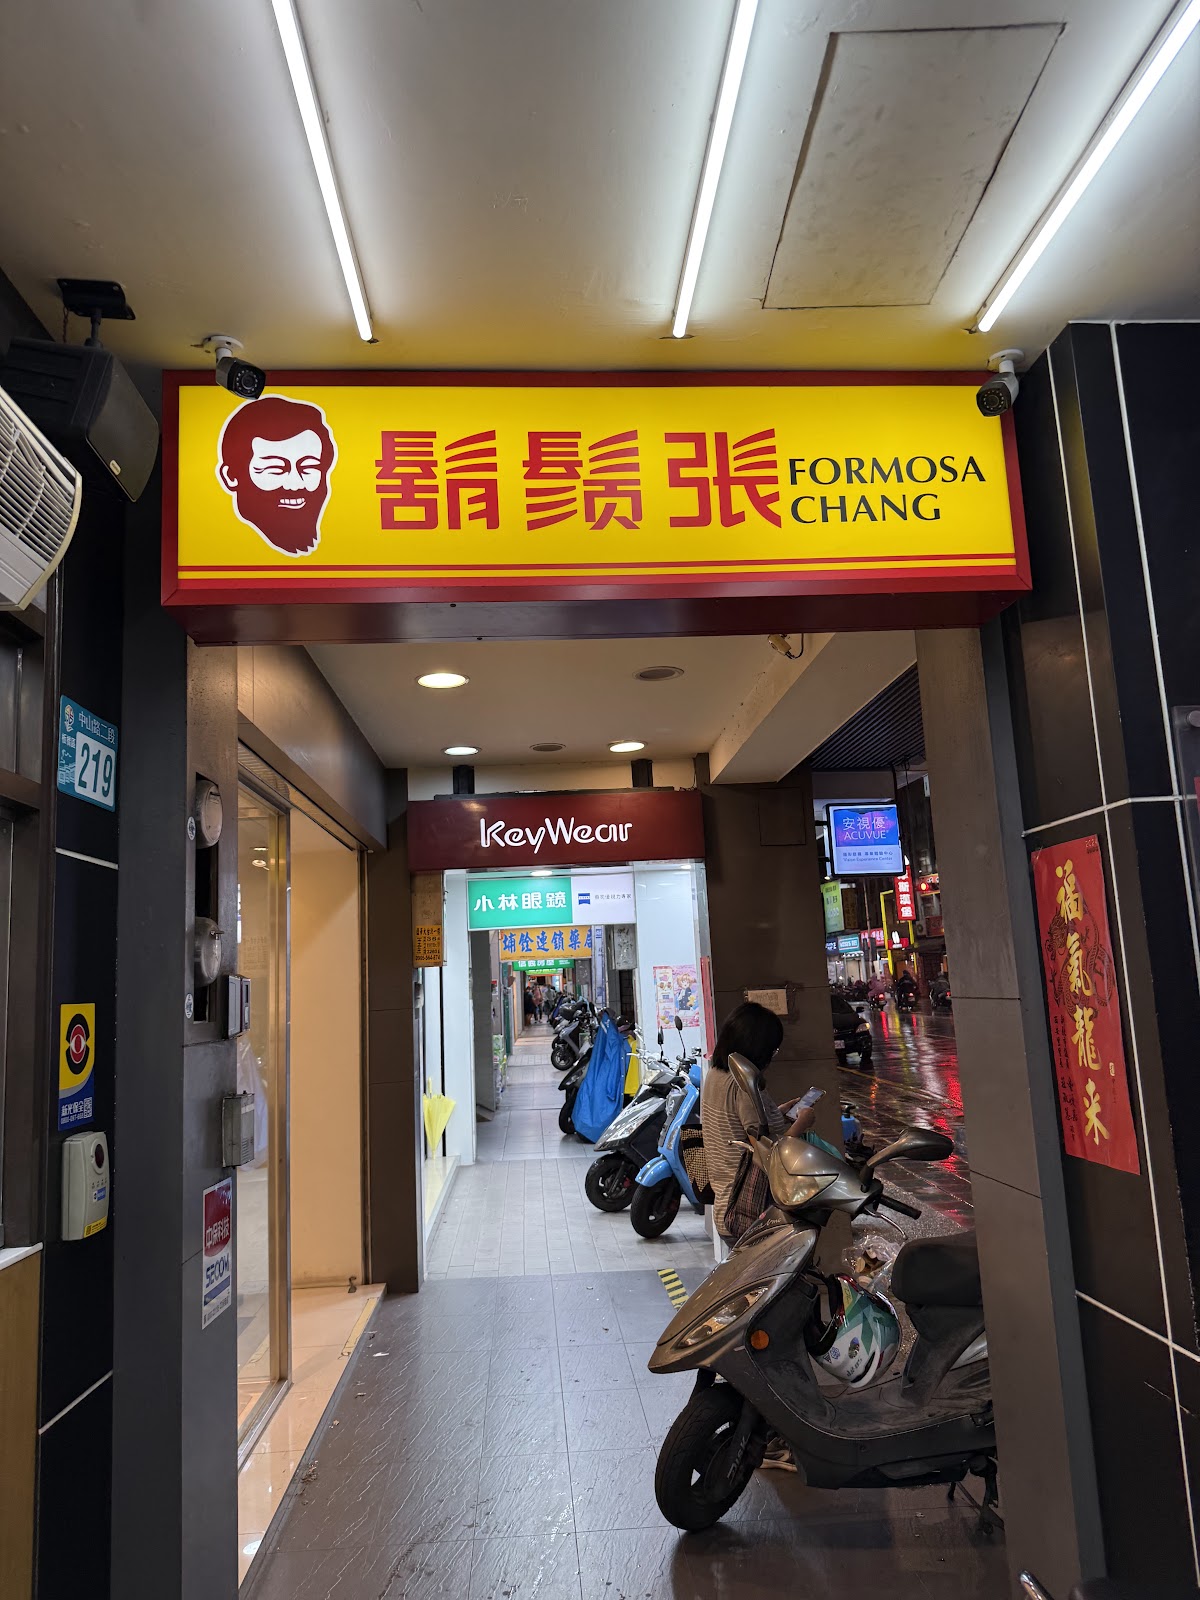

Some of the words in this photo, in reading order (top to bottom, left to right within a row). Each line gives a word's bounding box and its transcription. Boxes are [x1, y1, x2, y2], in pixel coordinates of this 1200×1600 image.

[375, 428, 782, 531] 鬍鬚張
[788, 455, 987, 487] FORMOSA
[790, 492, 943, 526] CHANG
[79, 711, 115, 744] 中山路二段
[78, 742, 113, 798] 219
[479, 816, 633, 854] KeyWear
[843, 816, 886, 831] 安視優
[843, 830, 887, 840] ACUVUE
[473, 891, 567, 912] 小林眼鏡
[205, 1216, 230, 1249] 中保科技
[205, 1252, 230, 1289] SECOM
